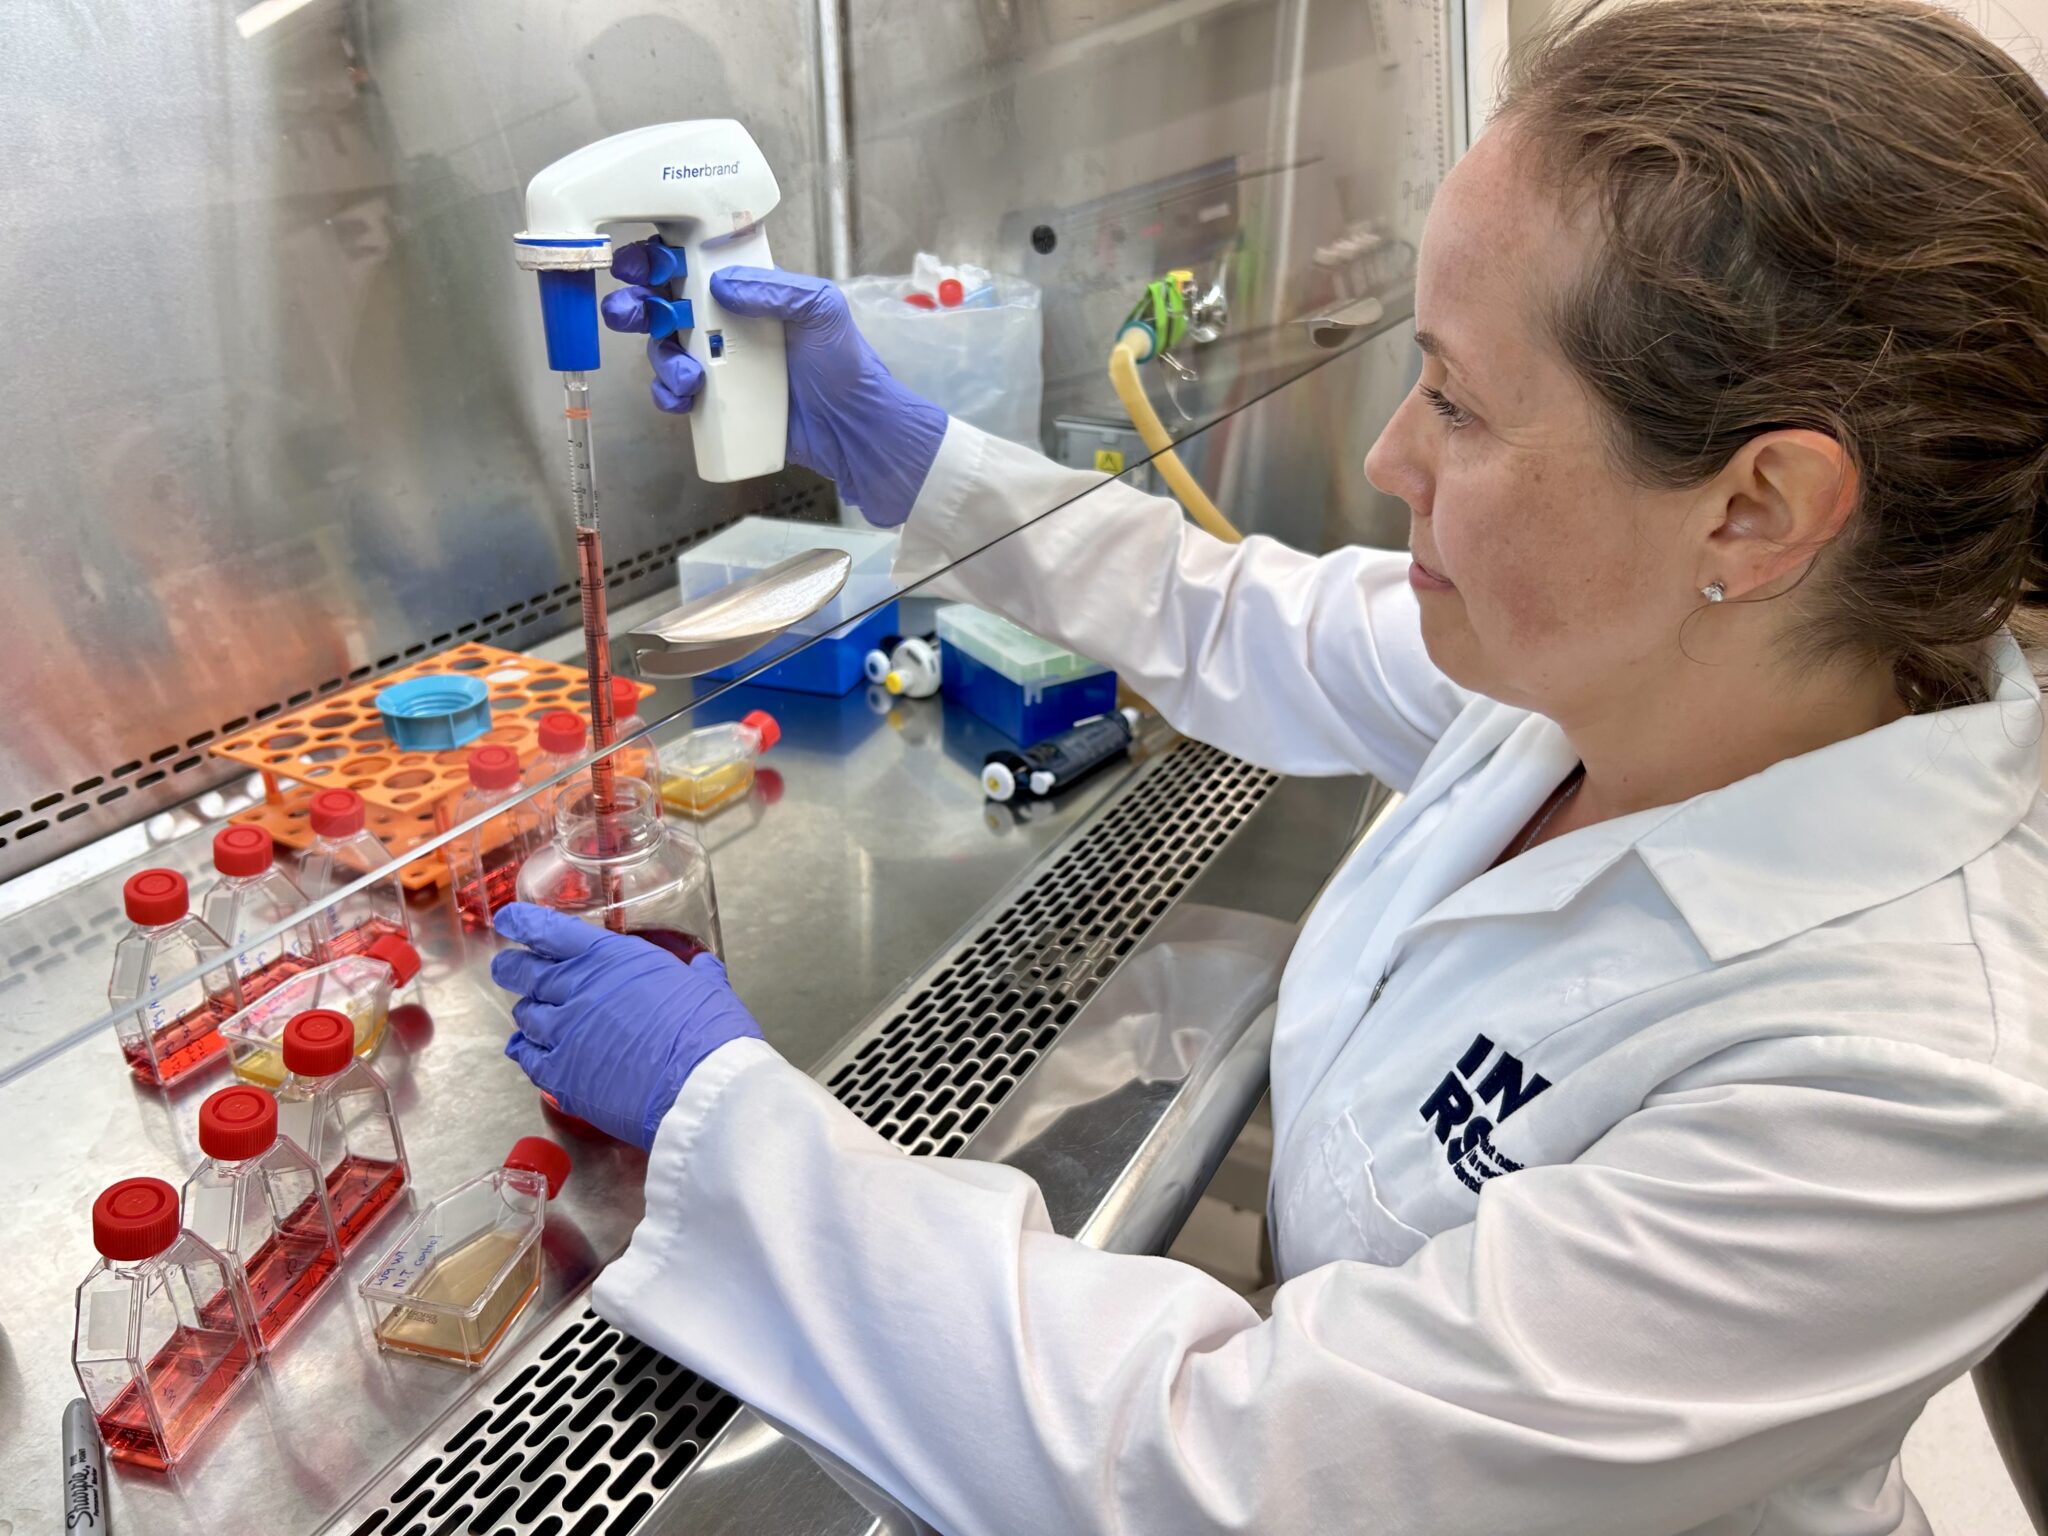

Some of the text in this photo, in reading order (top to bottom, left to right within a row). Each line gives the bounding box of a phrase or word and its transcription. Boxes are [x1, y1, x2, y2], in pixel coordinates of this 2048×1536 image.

[662, 162, 739, 181] Fisherbrand
[1419, 1070, 1494, 1165] RS
[1456, 1032, 1552, 1123] IN
